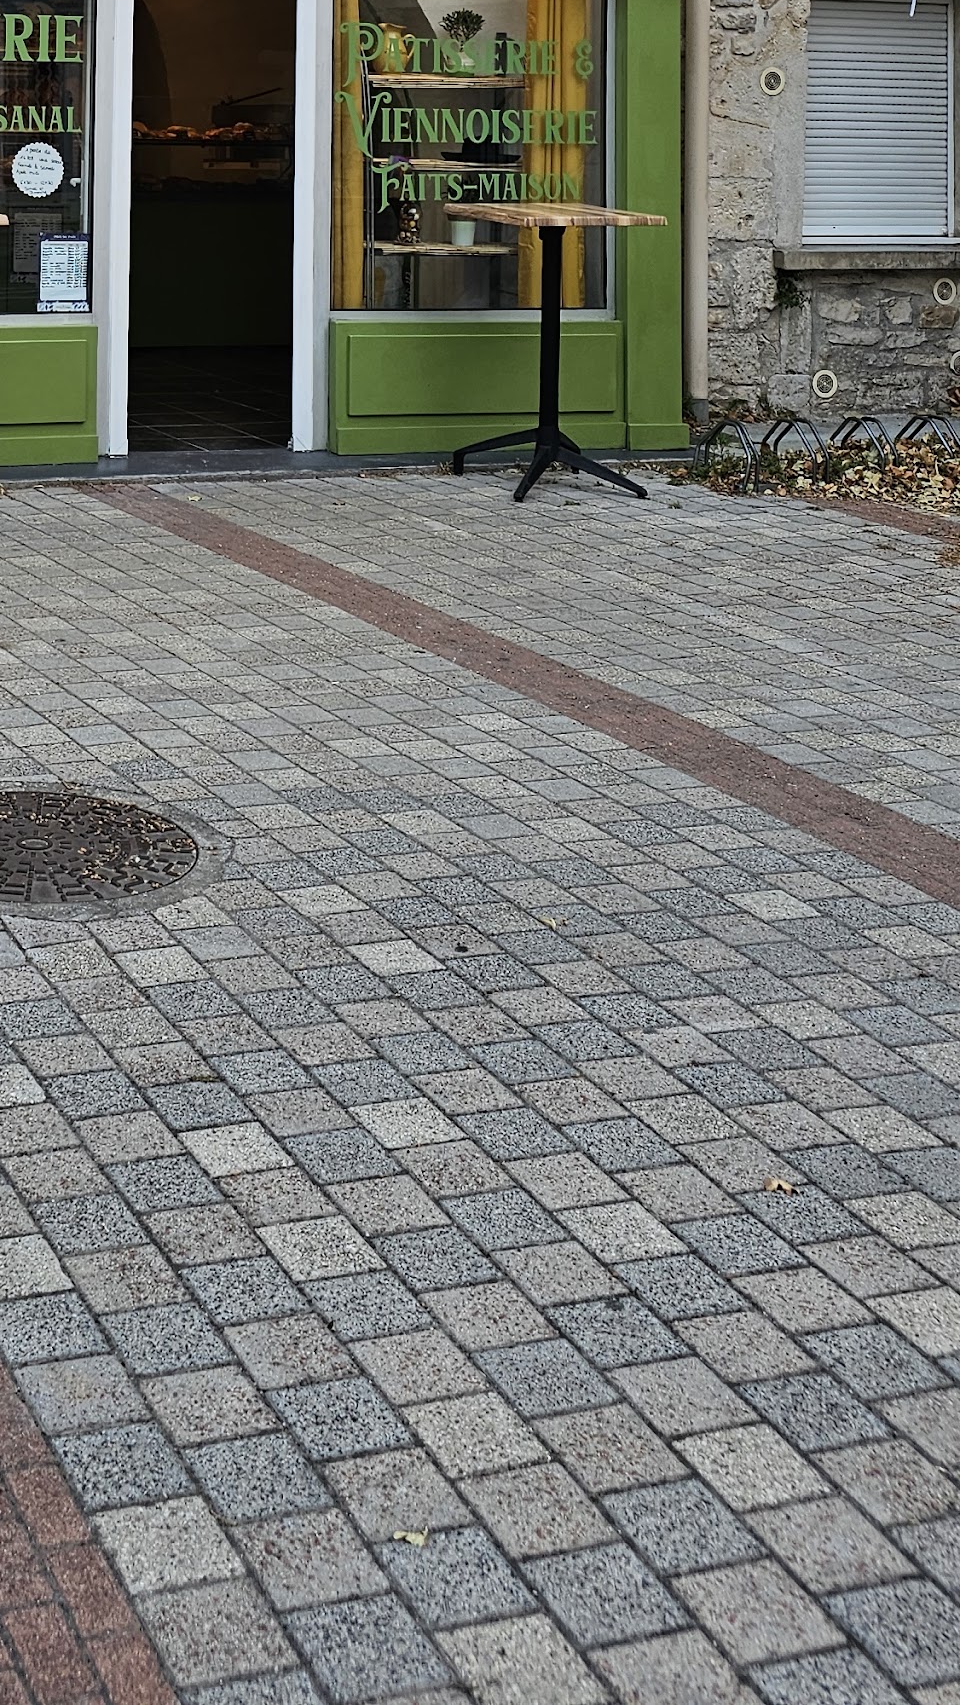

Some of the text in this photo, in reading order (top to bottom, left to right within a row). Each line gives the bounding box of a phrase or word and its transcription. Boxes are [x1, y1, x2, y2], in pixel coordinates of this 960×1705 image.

[575, 39, 594, 79] &
[334, 91, 599, 159] VIENNOISERIE
[371, 162, 581, 214] FAITS-MAISON
